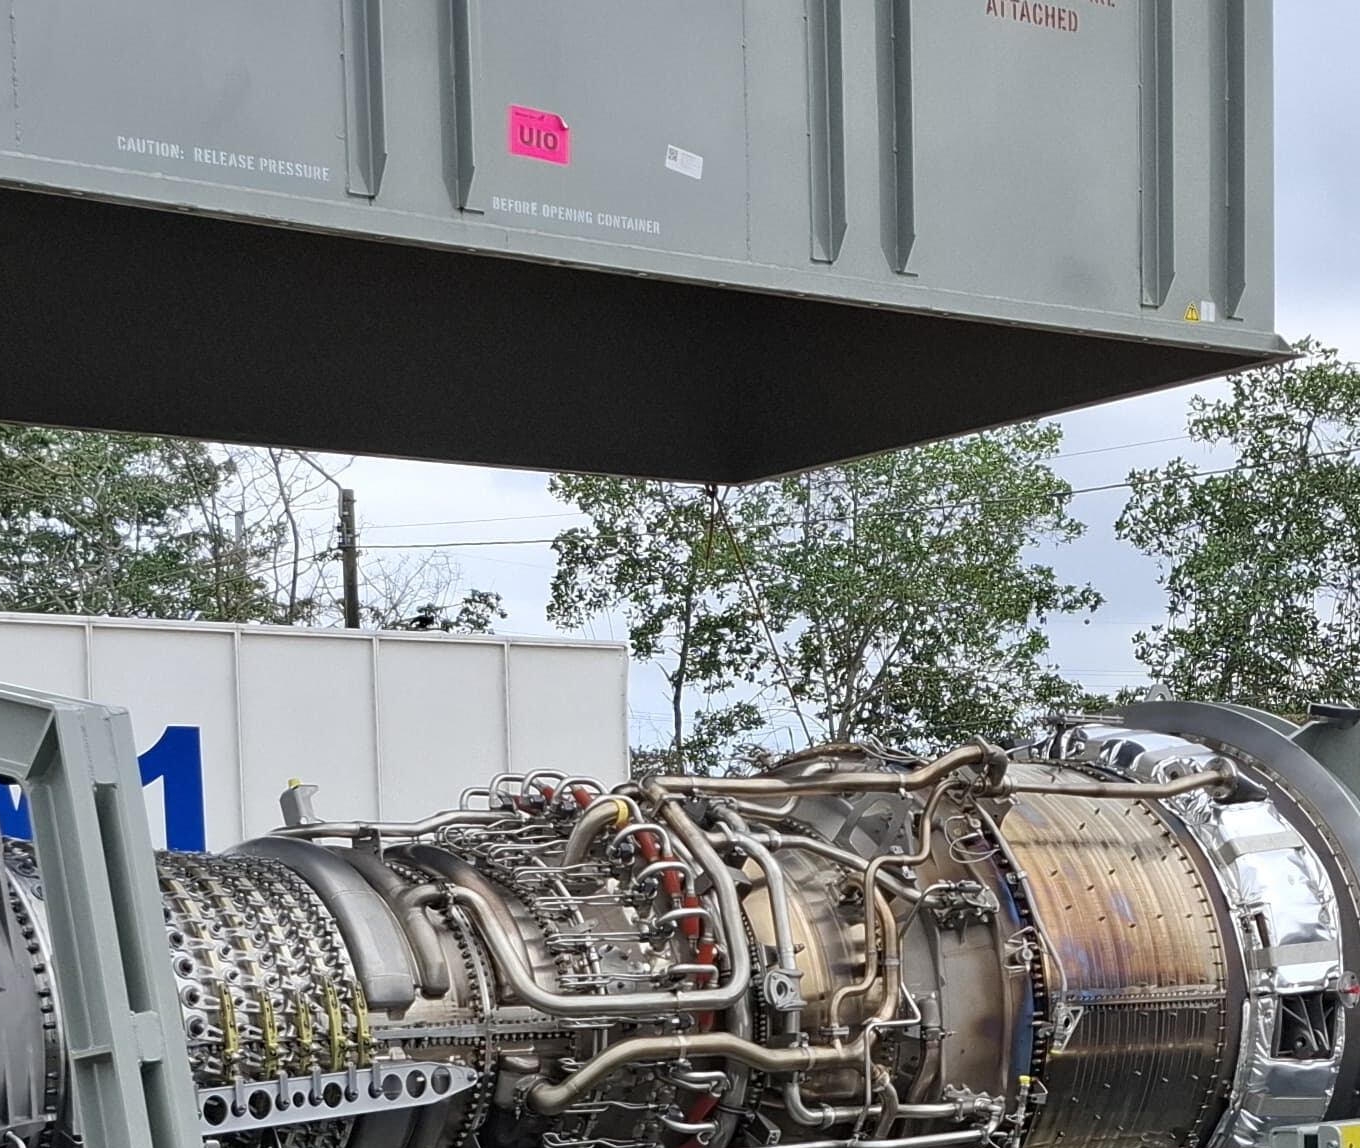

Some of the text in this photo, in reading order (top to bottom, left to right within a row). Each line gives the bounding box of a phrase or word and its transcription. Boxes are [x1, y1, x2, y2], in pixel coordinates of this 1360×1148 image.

[117, 135, 330, 181] CAUTION: RELEASE PRESSURE
[493, 196, 660, 234] BEFORE OPENING CONTAINER
